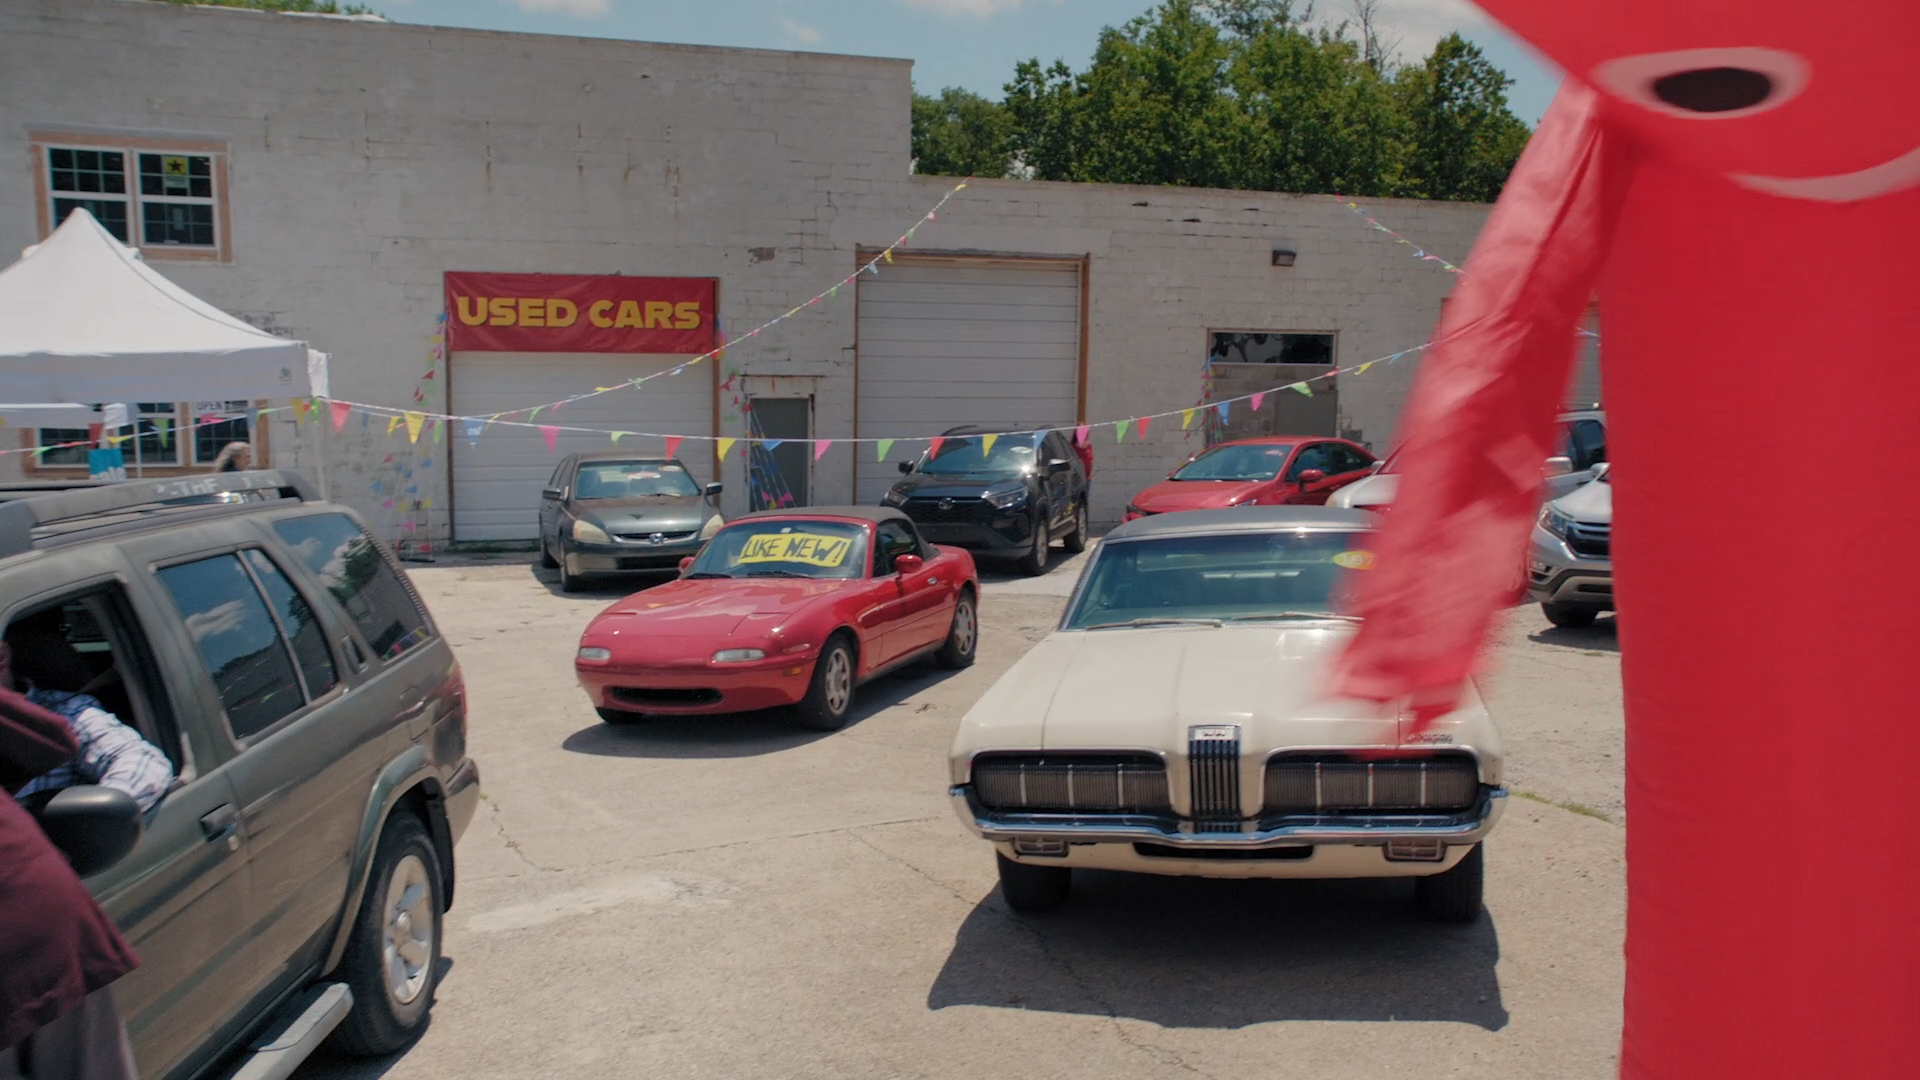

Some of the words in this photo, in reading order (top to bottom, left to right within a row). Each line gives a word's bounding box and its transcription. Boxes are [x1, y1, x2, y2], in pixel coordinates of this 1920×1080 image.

[457, 297, 578, 327] USED
[588, 299, 701, 329] CARS
[197, 401, 222, 410] OPEN
[741, 537, 783, 559] LIKE
[782, 537, 847, 563] NEW!
